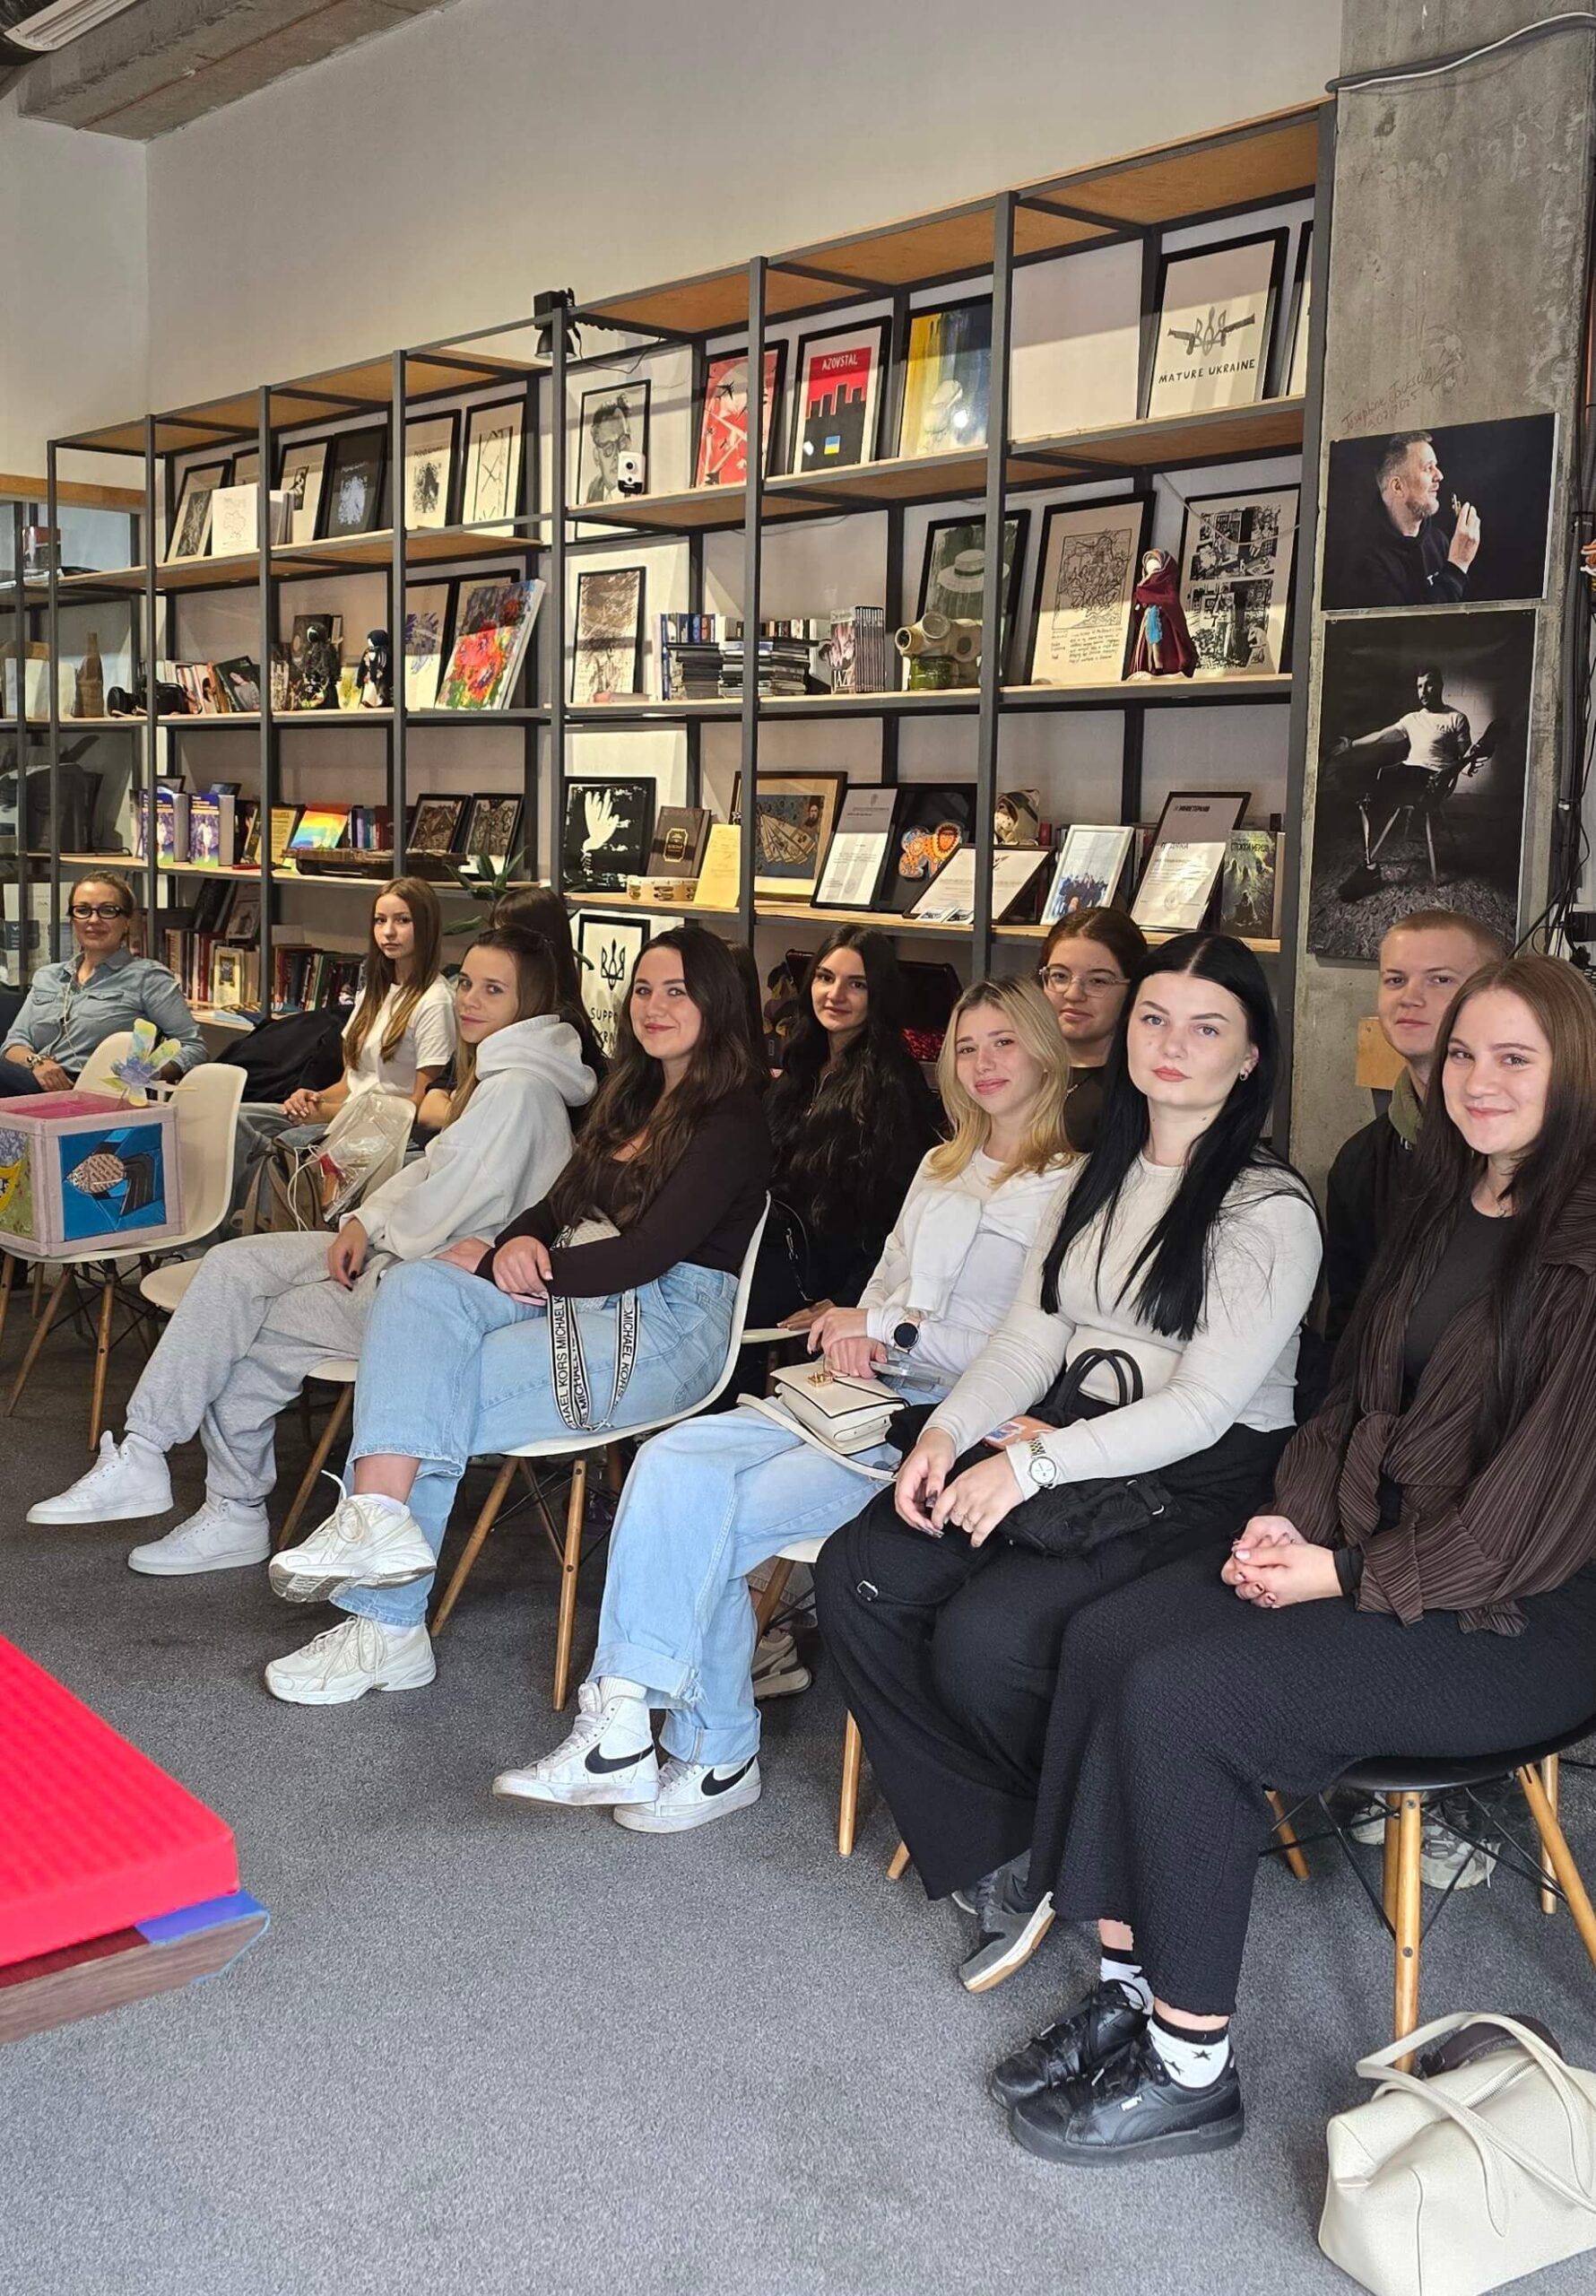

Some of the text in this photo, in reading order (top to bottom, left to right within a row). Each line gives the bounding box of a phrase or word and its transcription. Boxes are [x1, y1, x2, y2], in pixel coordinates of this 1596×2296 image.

[821, 353, 858, 371] AZOVSTAL
[1158, 359, 1255, 384] MATURE UKRAINE
[554, 1306, 567, 1350] MICHAEL
[622, 1310, 634, 1359] MICHAEL
[556, 1352, 568, 1387] KORS
